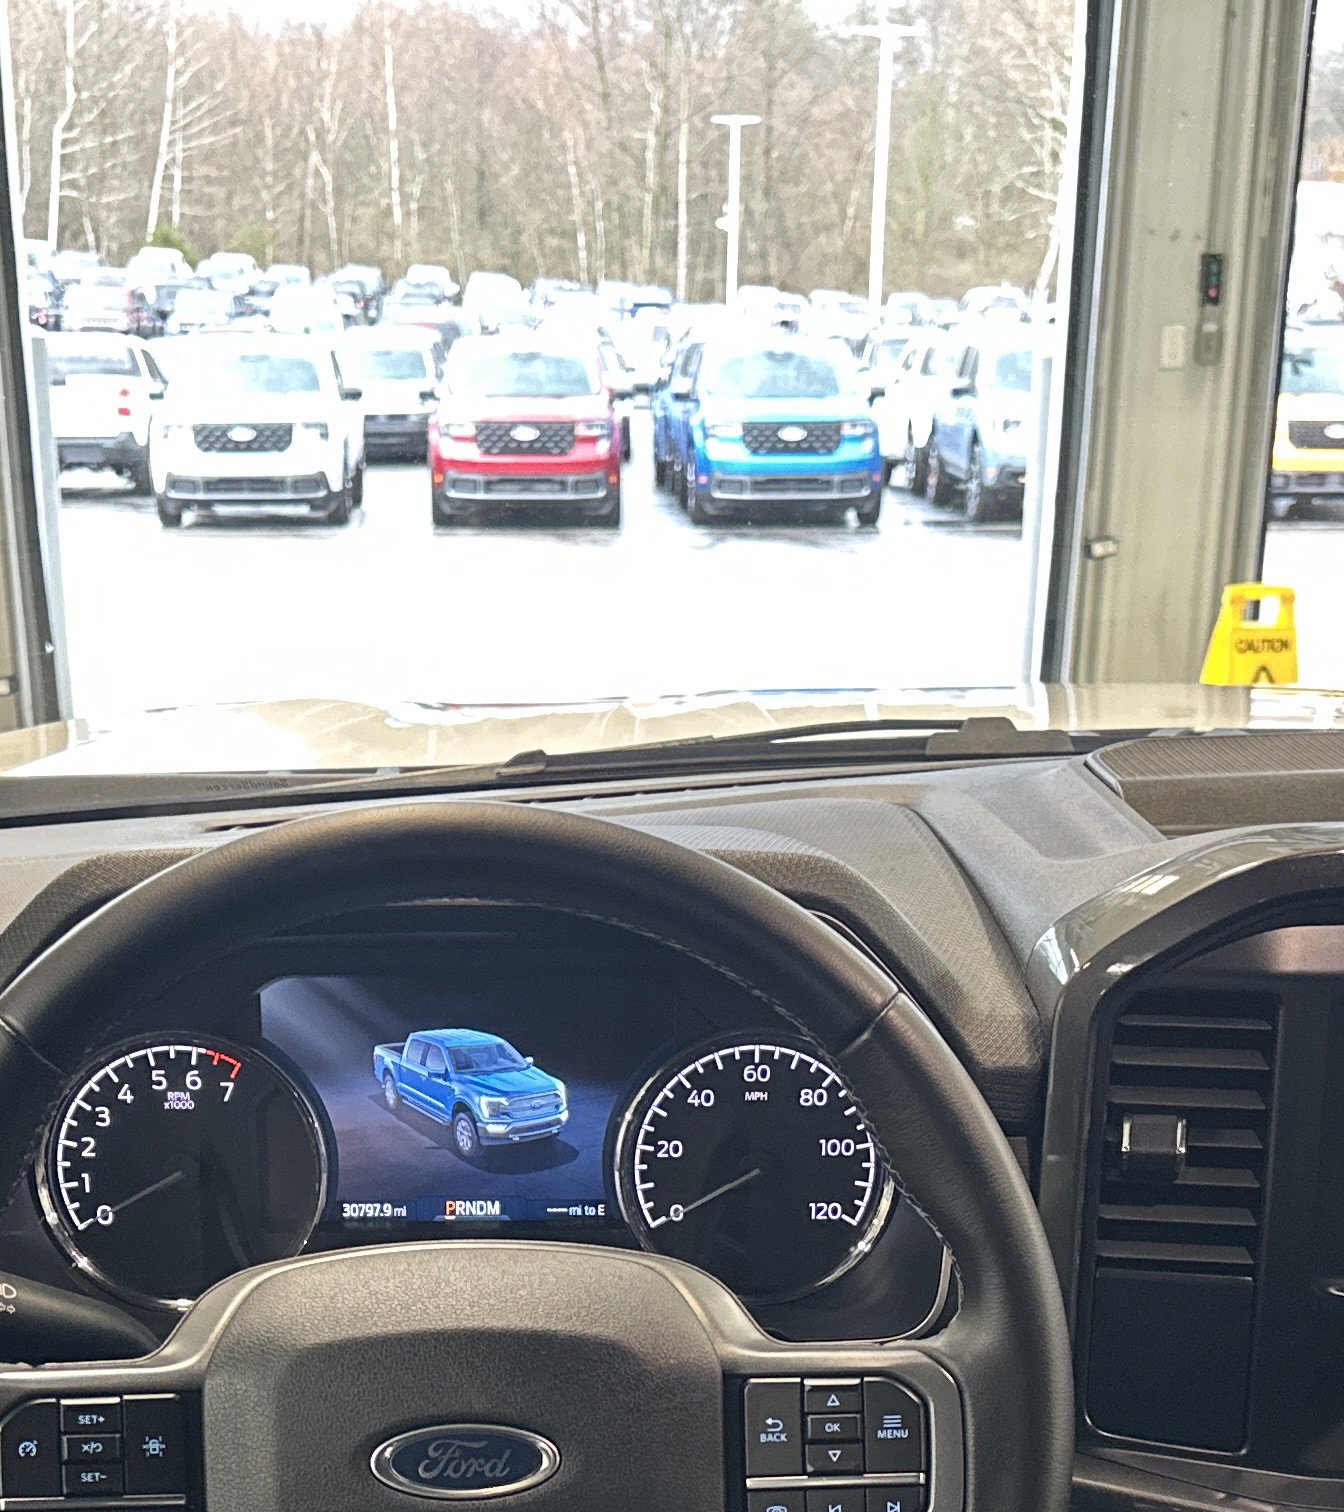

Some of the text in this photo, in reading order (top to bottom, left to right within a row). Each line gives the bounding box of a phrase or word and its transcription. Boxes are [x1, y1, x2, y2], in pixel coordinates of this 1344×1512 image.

[151, 1069, 167, 1090] 5
[185, 1069, 202, 1090] 6
[743, 1064, 771, 1082] 60
[117, 1083, 134, 1104] 4
[167, 1091, 190, 1101] RPM
[219, 1081, 235, 1102] 7
[687, 1089, 715, 1107] 40
[744, 1091, 768, 1101] MPH
[799, 1088, 828, 1106] 80
[163, 1100, 195, 1110] x1000
[94, 1106, 111, 1127] 3
[80, 1136, 97, 1157] 2
[656, 1140, 683, 1158] 20
[819, 1138, 855, 1156] 100
[80, 1172, 91, 1193] 1
[96, 1204, 114, 1226] 0
[341, 1203, 407, 1218] 30797.9 mi
[568, 1203, 606, 1216] mi to E
[669, 1203, 684, 1222] 0
[808, 1202, 842, 1220] 120
[824, 1422, 841, 1433] OK
[877, 1428, 909, 1439] MENU
[759, 1433, 788, 1443] BACK
[417, 1438, 512, 1480] Ford
